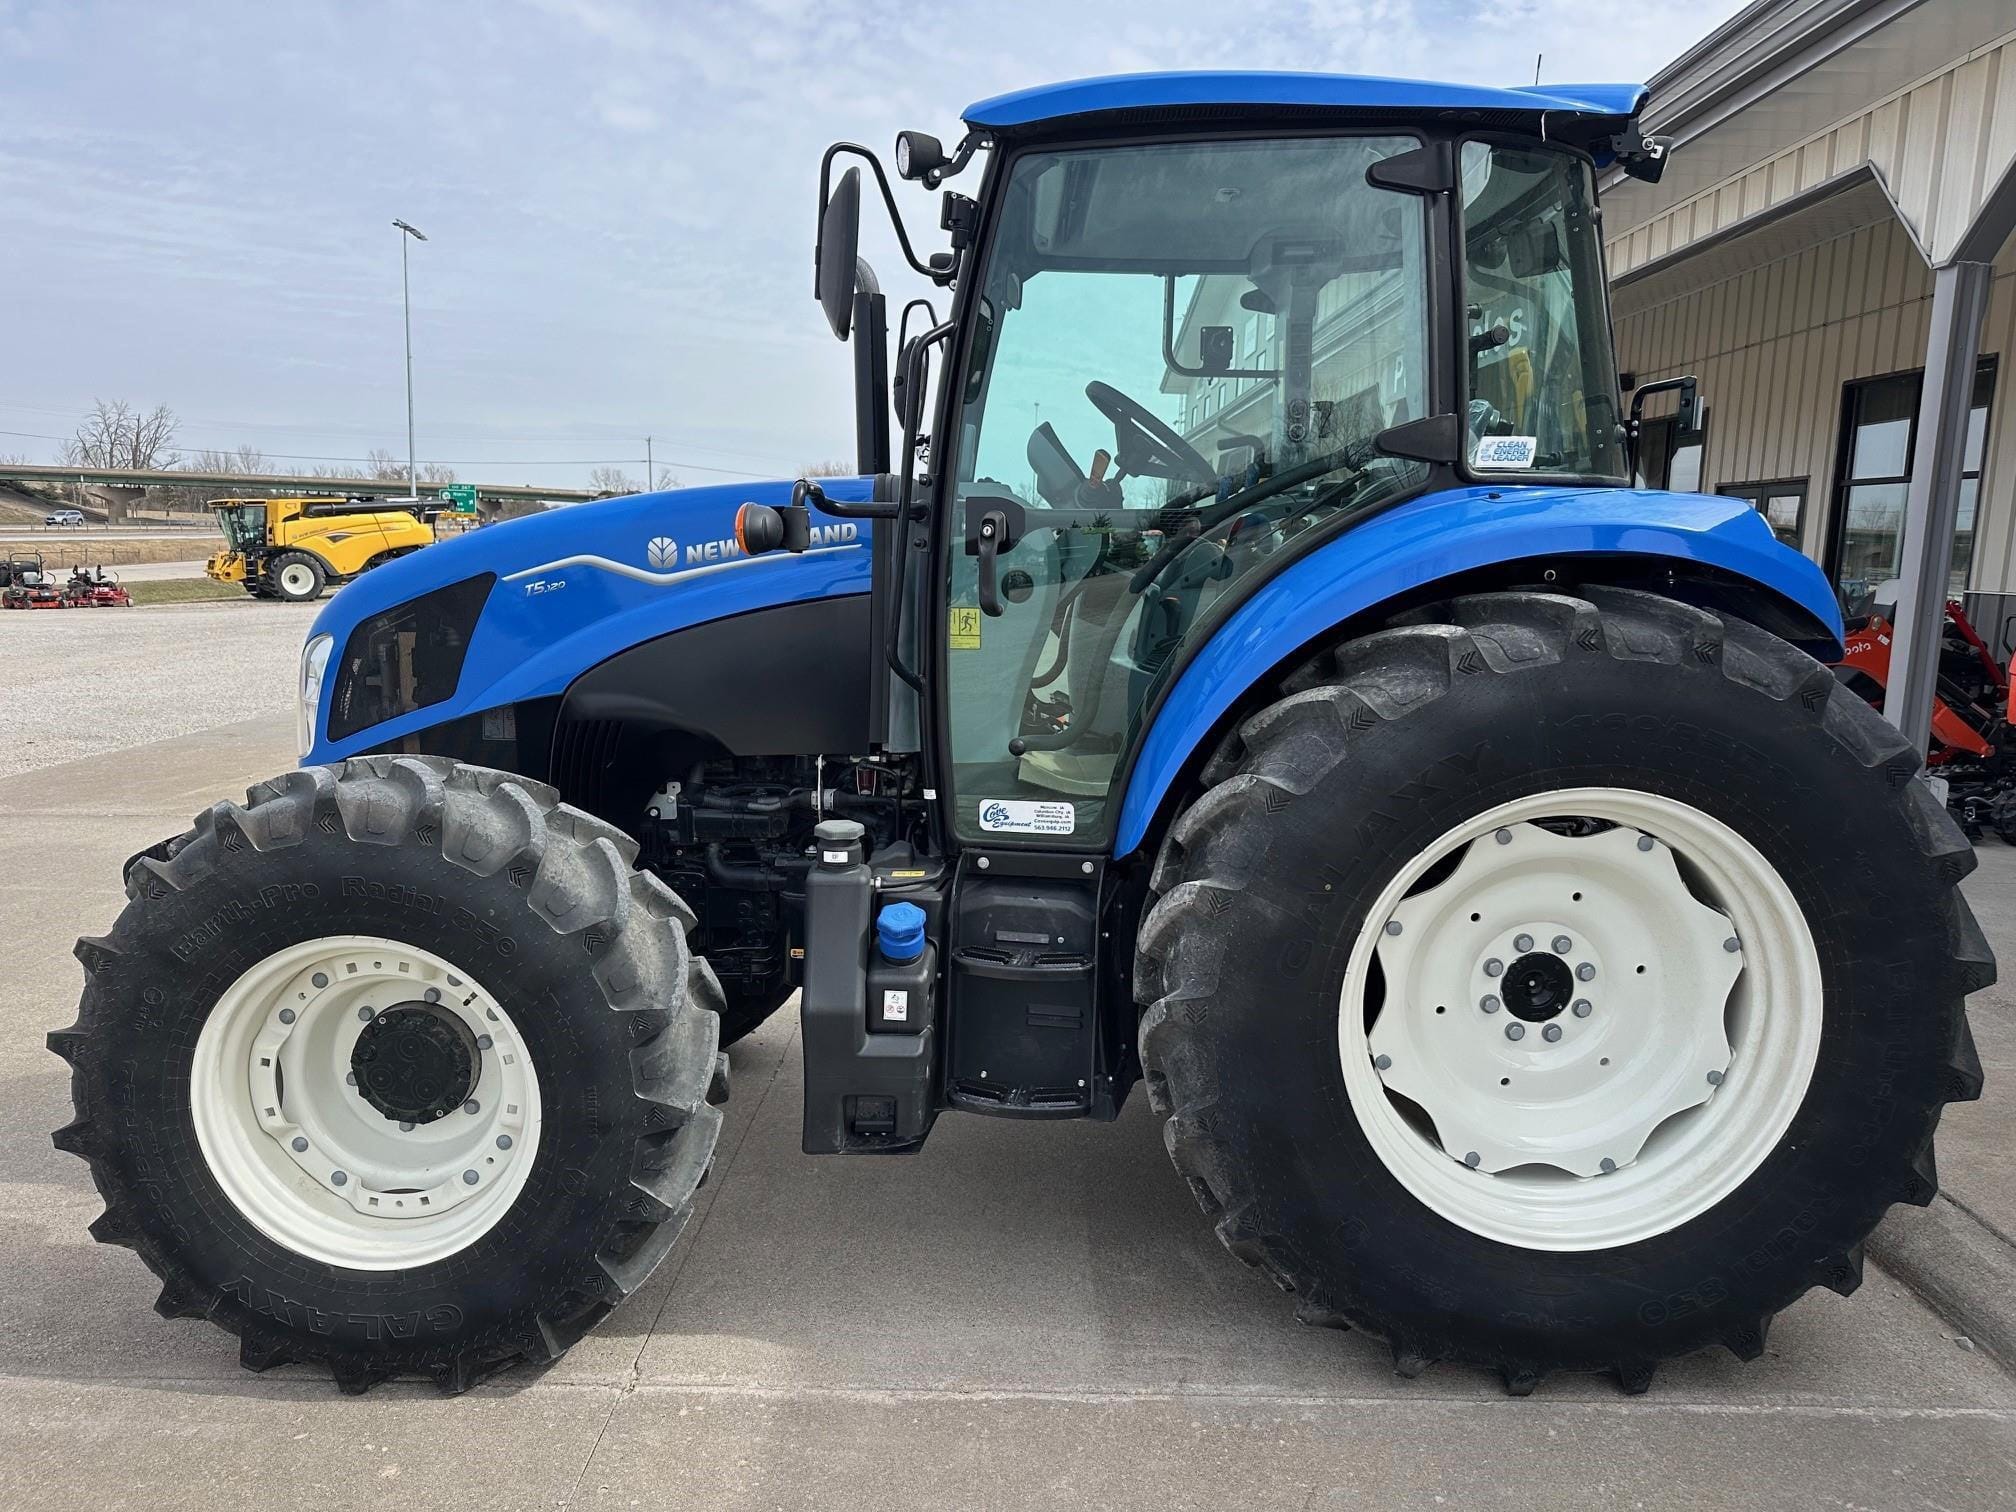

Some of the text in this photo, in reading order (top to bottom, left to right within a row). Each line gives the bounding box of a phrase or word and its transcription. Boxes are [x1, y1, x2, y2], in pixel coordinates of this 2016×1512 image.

[1491, 454, 1529, 462] LEADER
[1493, 447, 1533, 455] ENERGY
[686, 537, 740, 564] NEW
[525, 580, 566, 597] T5.120
[983, 803, 1009, 822] Cove
[992, 818, 1031, 829] Equipment
[1276, 739, 1492, 980] GALAXY
[169, 875, 518, 962] Earth-Pro Radial 850
[207, 1274, 464, 1340] GALAXY
